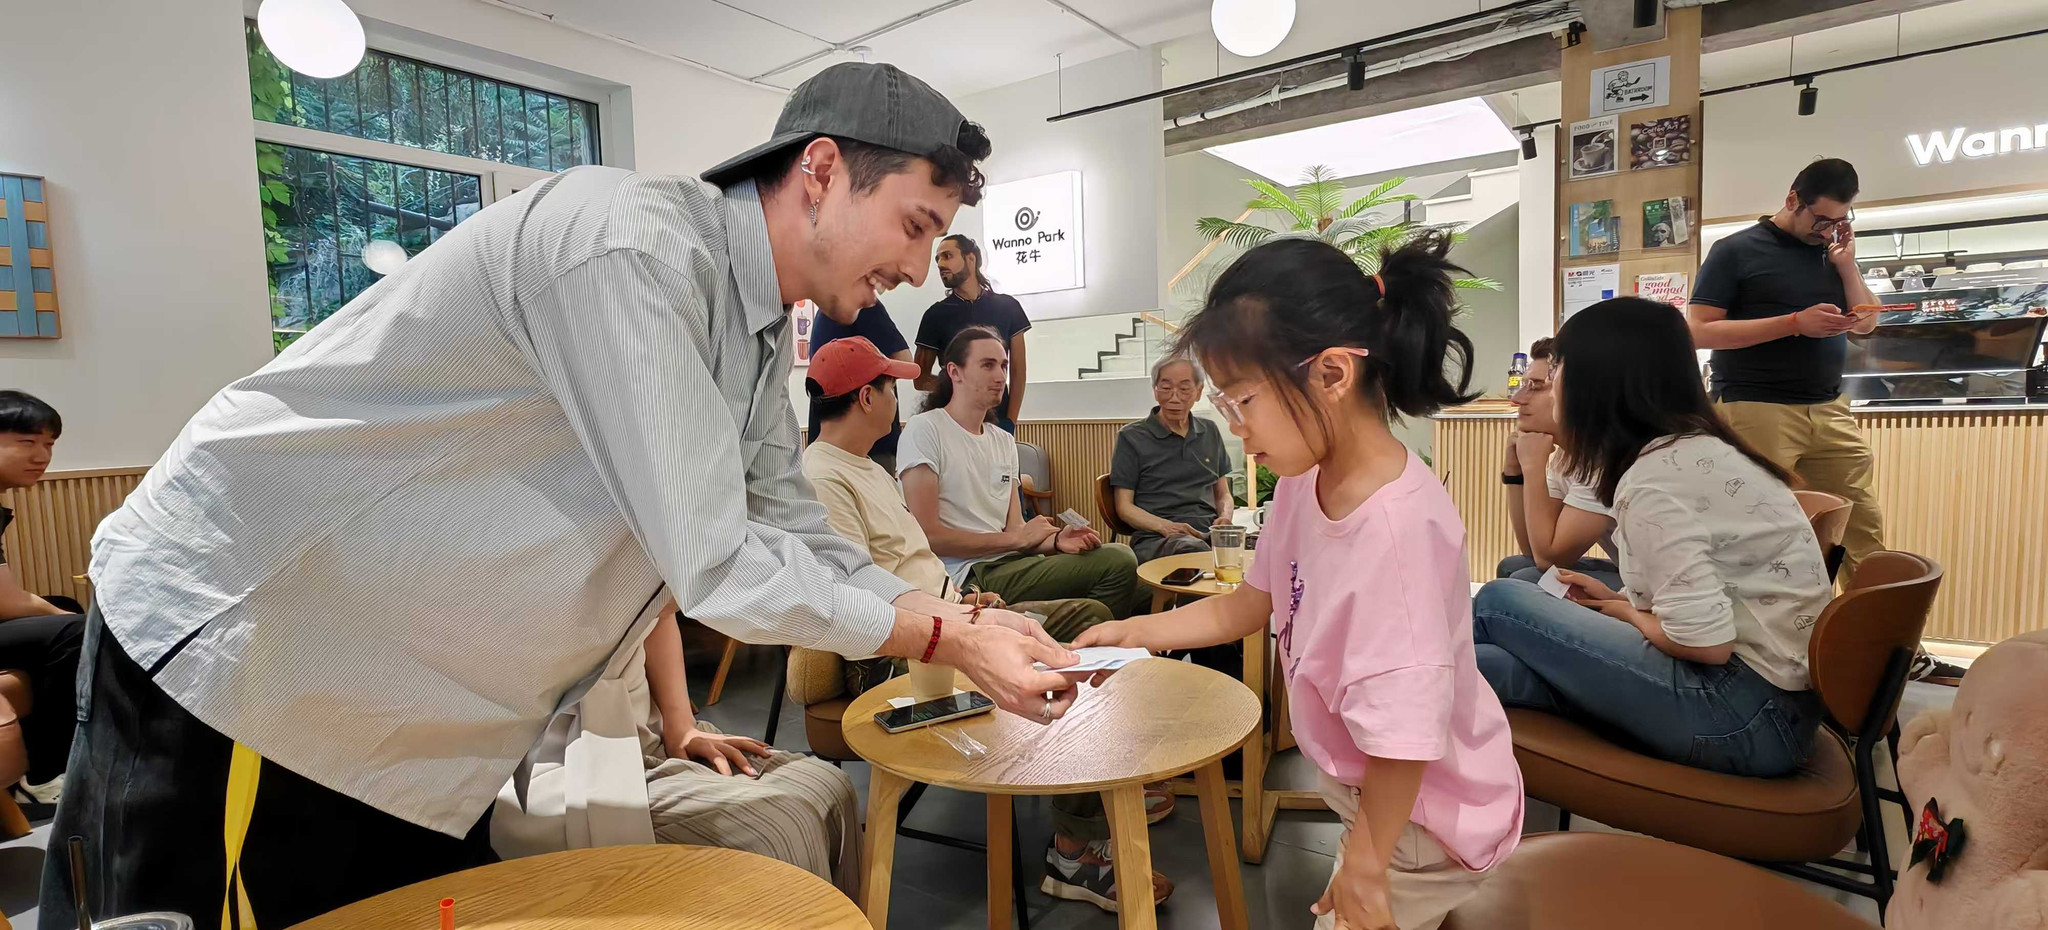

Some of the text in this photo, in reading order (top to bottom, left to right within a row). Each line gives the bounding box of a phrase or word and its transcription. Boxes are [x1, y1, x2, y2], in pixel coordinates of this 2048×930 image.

[1574, 123, 1590, 132] FOOD
[1642, 123, 1665, 135] Coffee
[992, 229, 1065, 250] Wanno Park
[1016, 249, 1041, 265] 花牛
[1643, 277, 1672, 291] good
[1651, 283, 1685, 295] mood
[1921, 299, 1957, 309] grow
